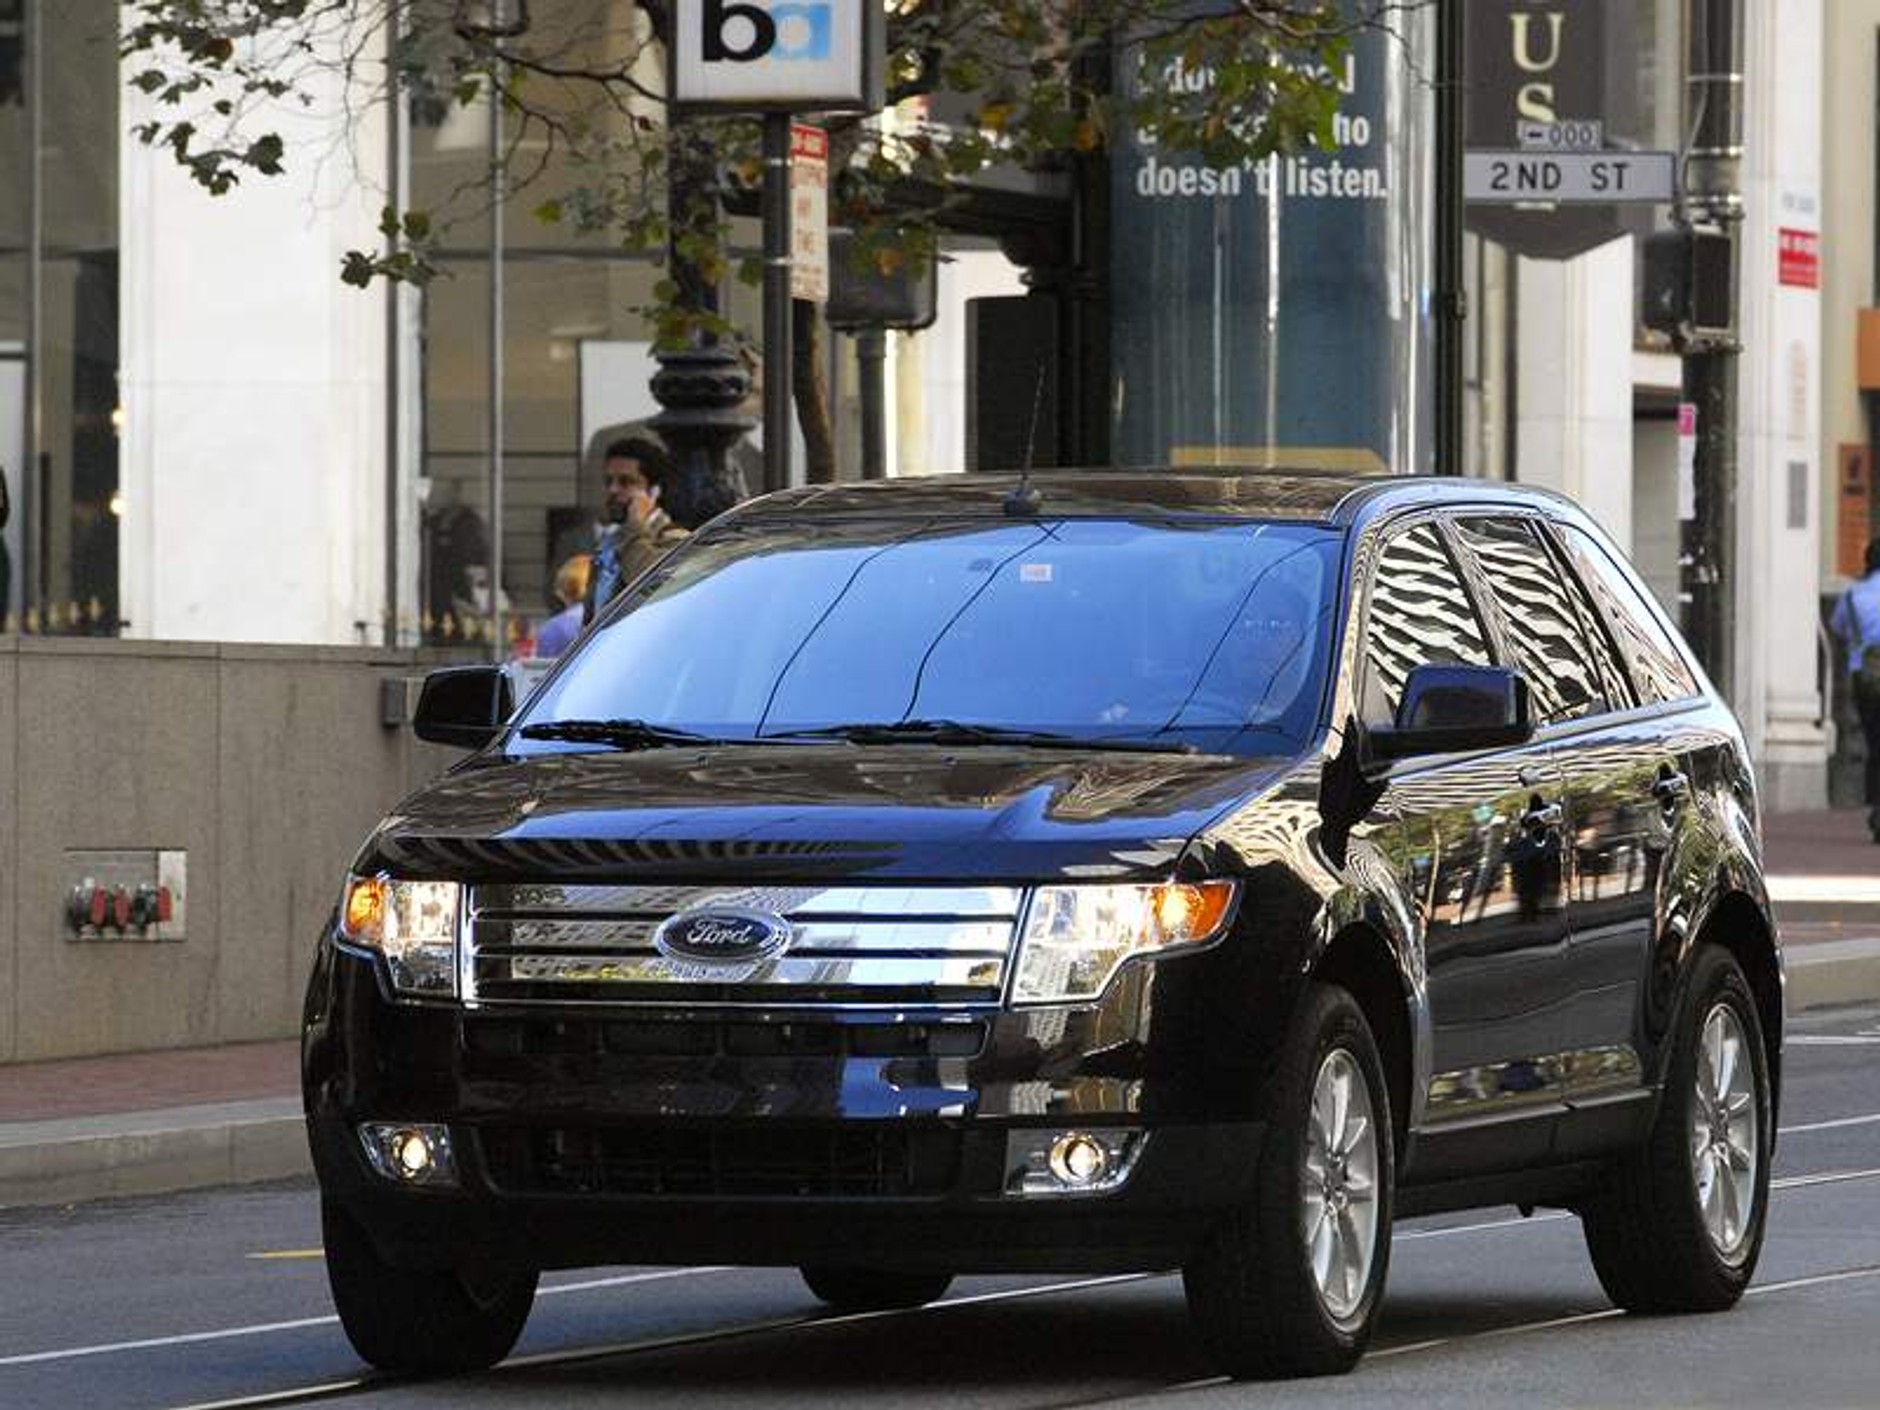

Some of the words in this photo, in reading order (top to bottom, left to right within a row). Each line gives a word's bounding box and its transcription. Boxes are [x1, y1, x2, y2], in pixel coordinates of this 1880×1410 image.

[1306, 112, 1370, 146] ho
[1137, 156, 1271, 196] doesn't
[1286, 157, 1388, 198] listen.
[1490, 162, 1562, 191] 2ND
[1591, 162, 1630, 191] ST
[687, 918, 751, 944] Ford
